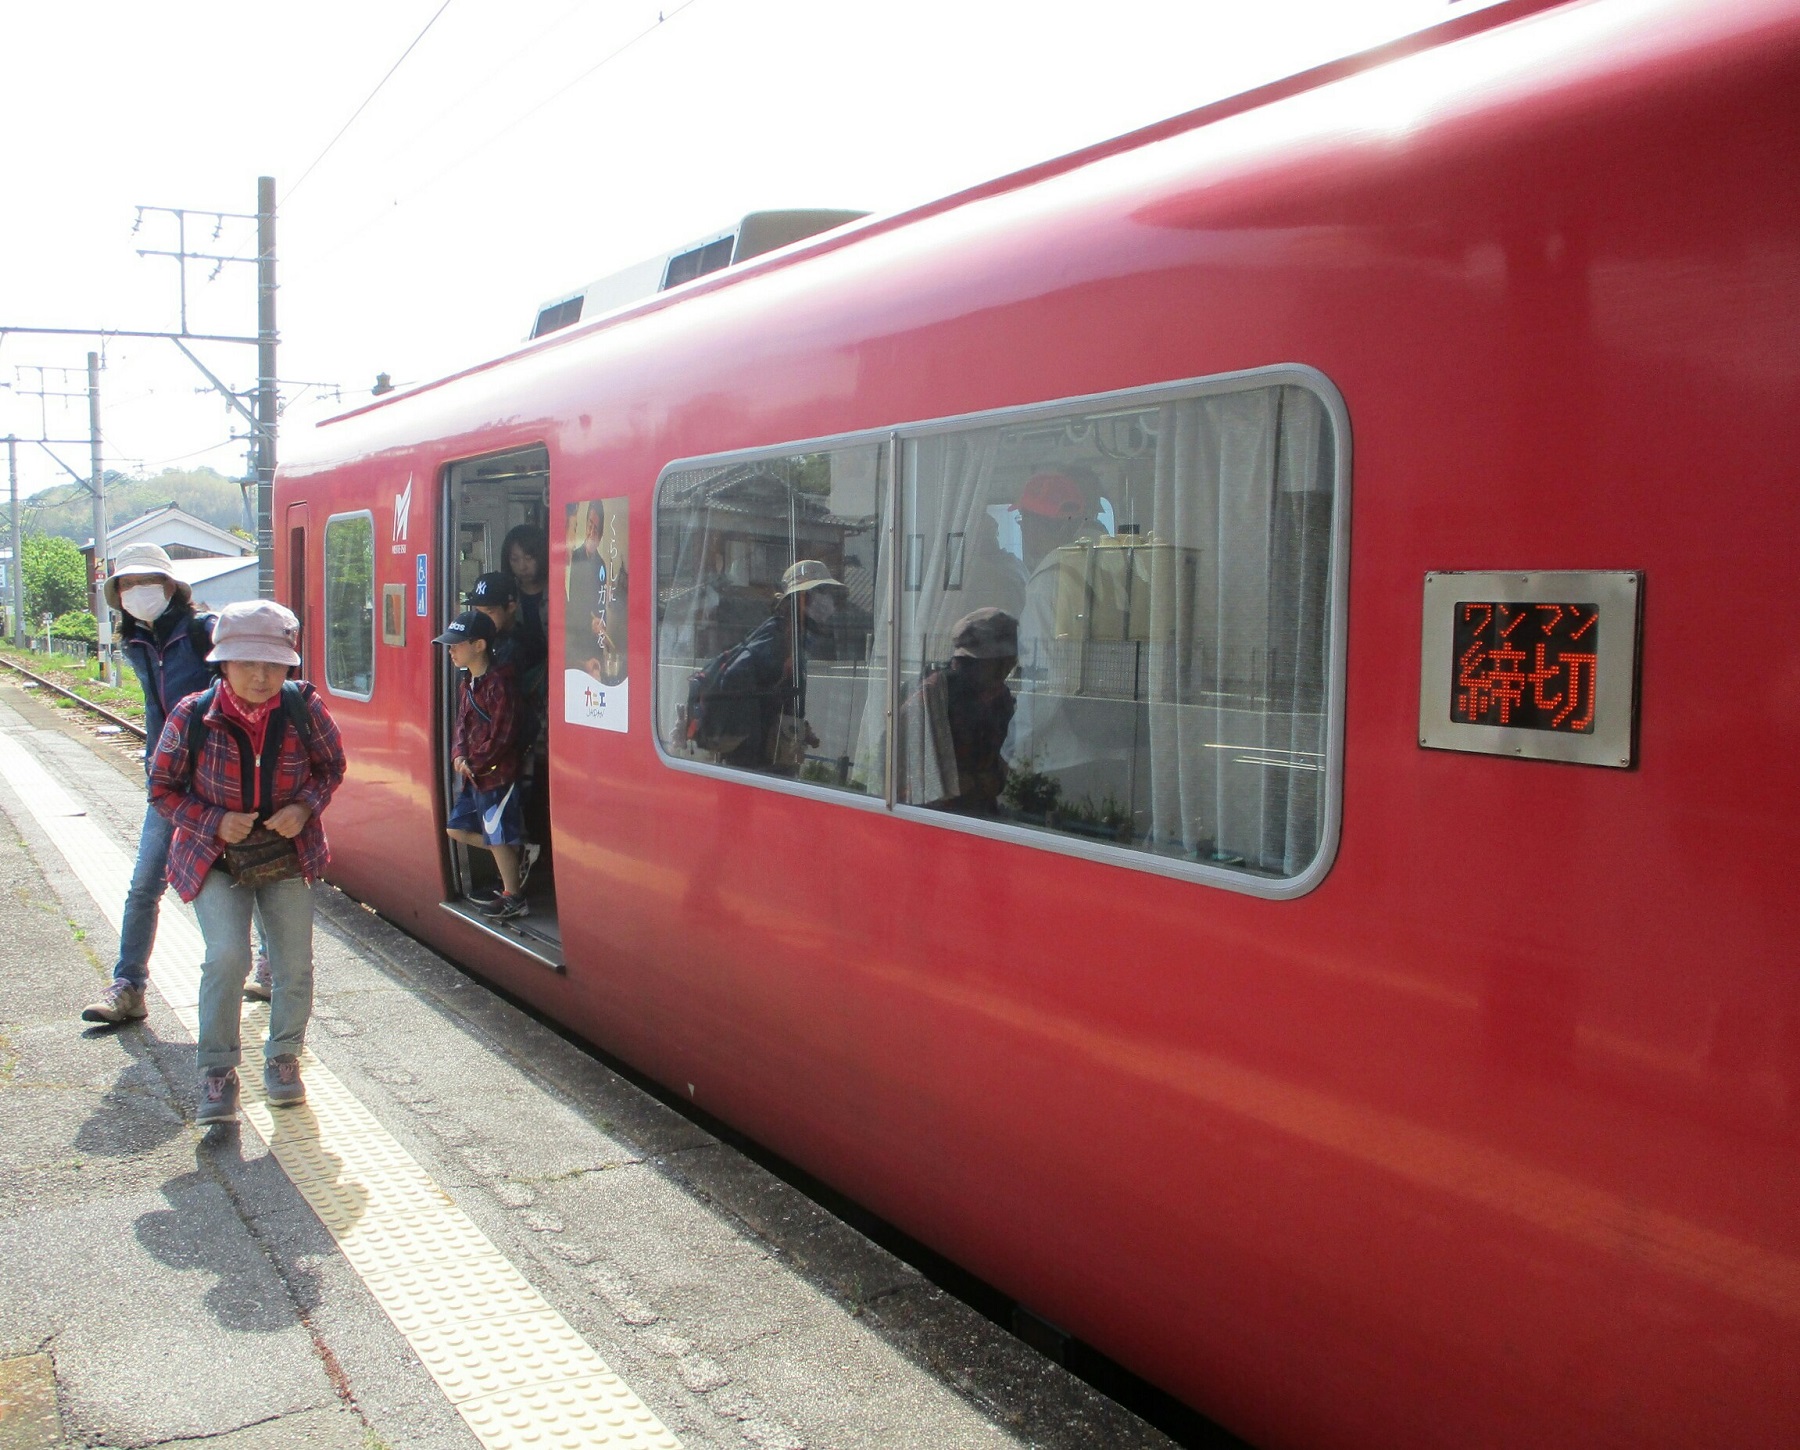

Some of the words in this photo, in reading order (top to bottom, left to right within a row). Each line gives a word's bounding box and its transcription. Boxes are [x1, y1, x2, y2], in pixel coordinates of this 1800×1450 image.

[608, 514, 618, 602] くらしに
[598, 585, 608, 649] ガスを
[1465, 604, 1598, 640] ワンマン
[1459, 641, 1597, 730] 締切
